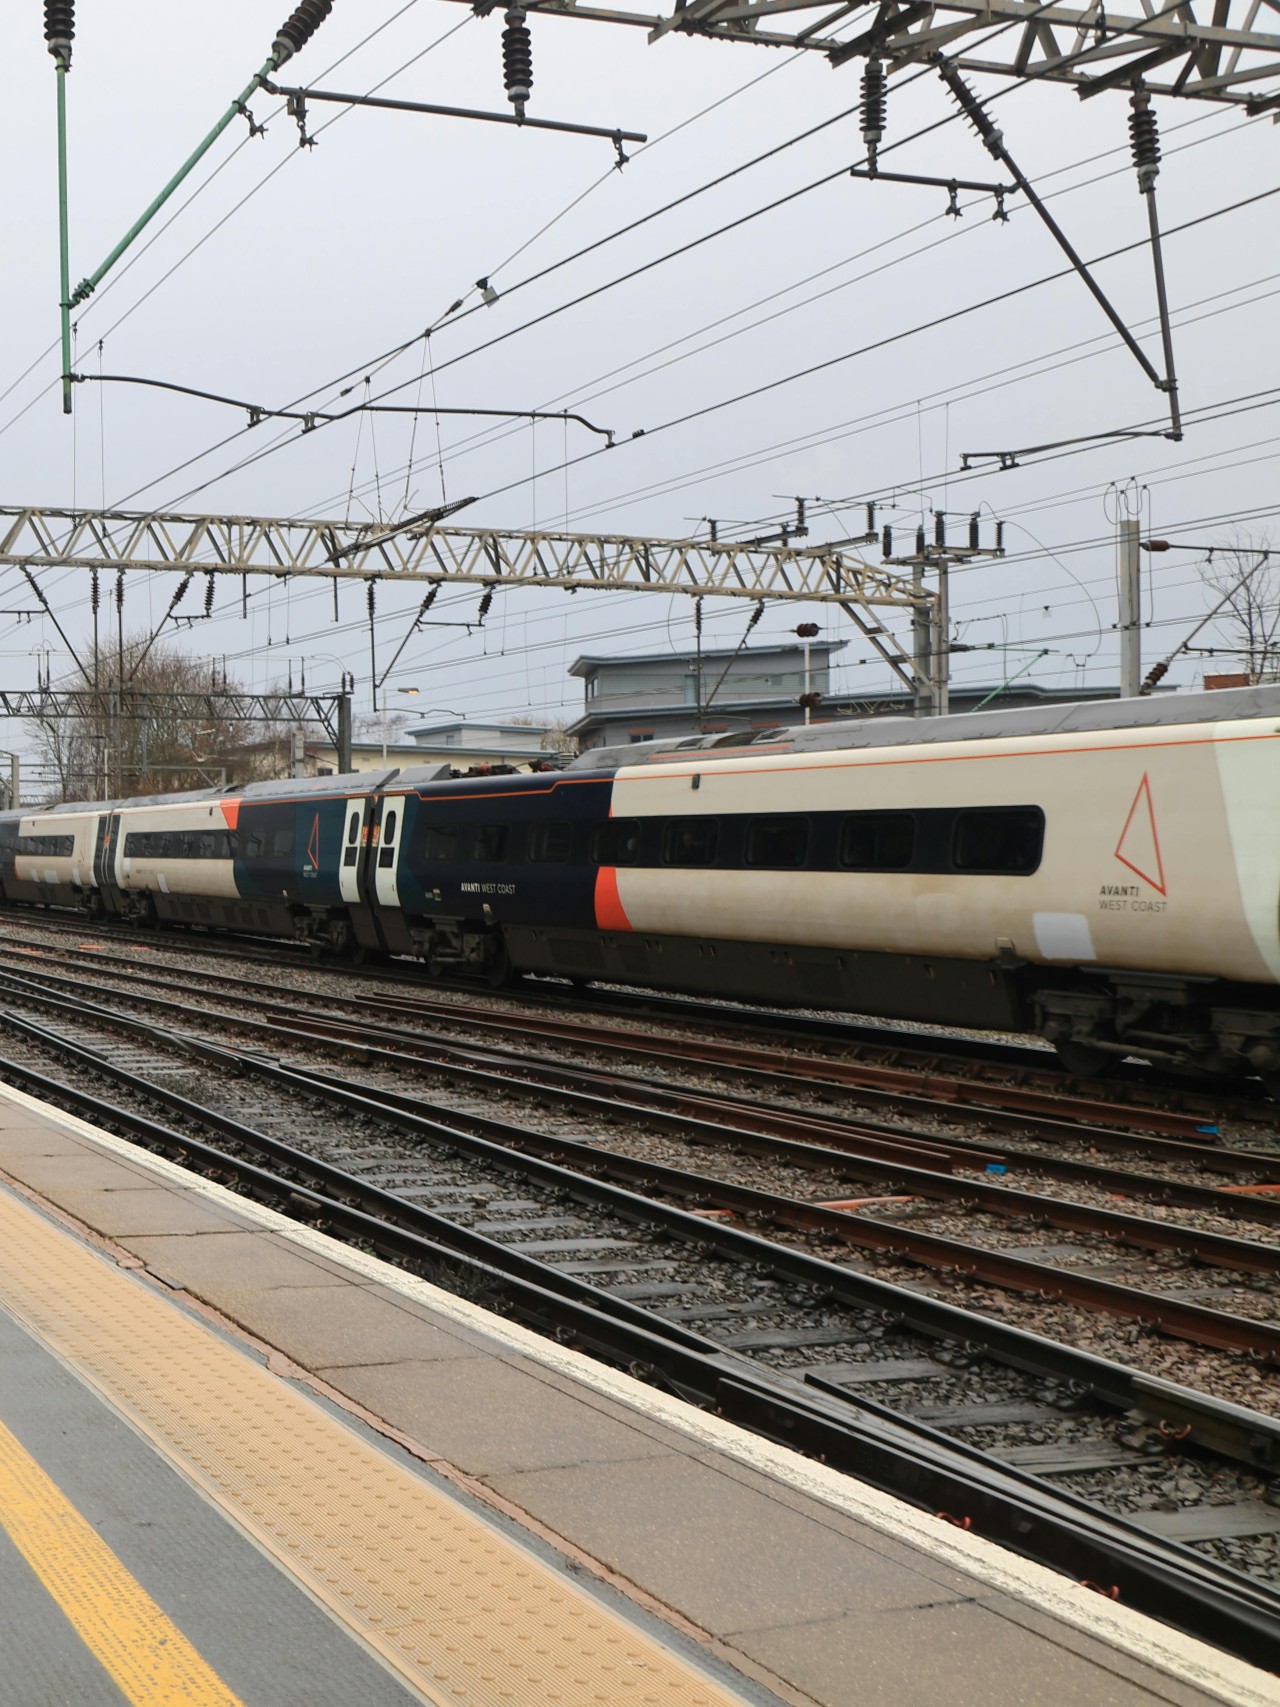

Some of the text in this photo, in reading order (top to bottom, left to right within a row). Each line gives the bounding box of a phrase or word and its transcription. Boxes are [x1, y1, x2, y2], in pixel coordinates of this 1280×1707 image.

[460, 882, 516, 895] AVANTI WEST COAST
[1099, 885, 1140, 896] AVANTI
[1099, 900, 1168, 912] WEST COAST
